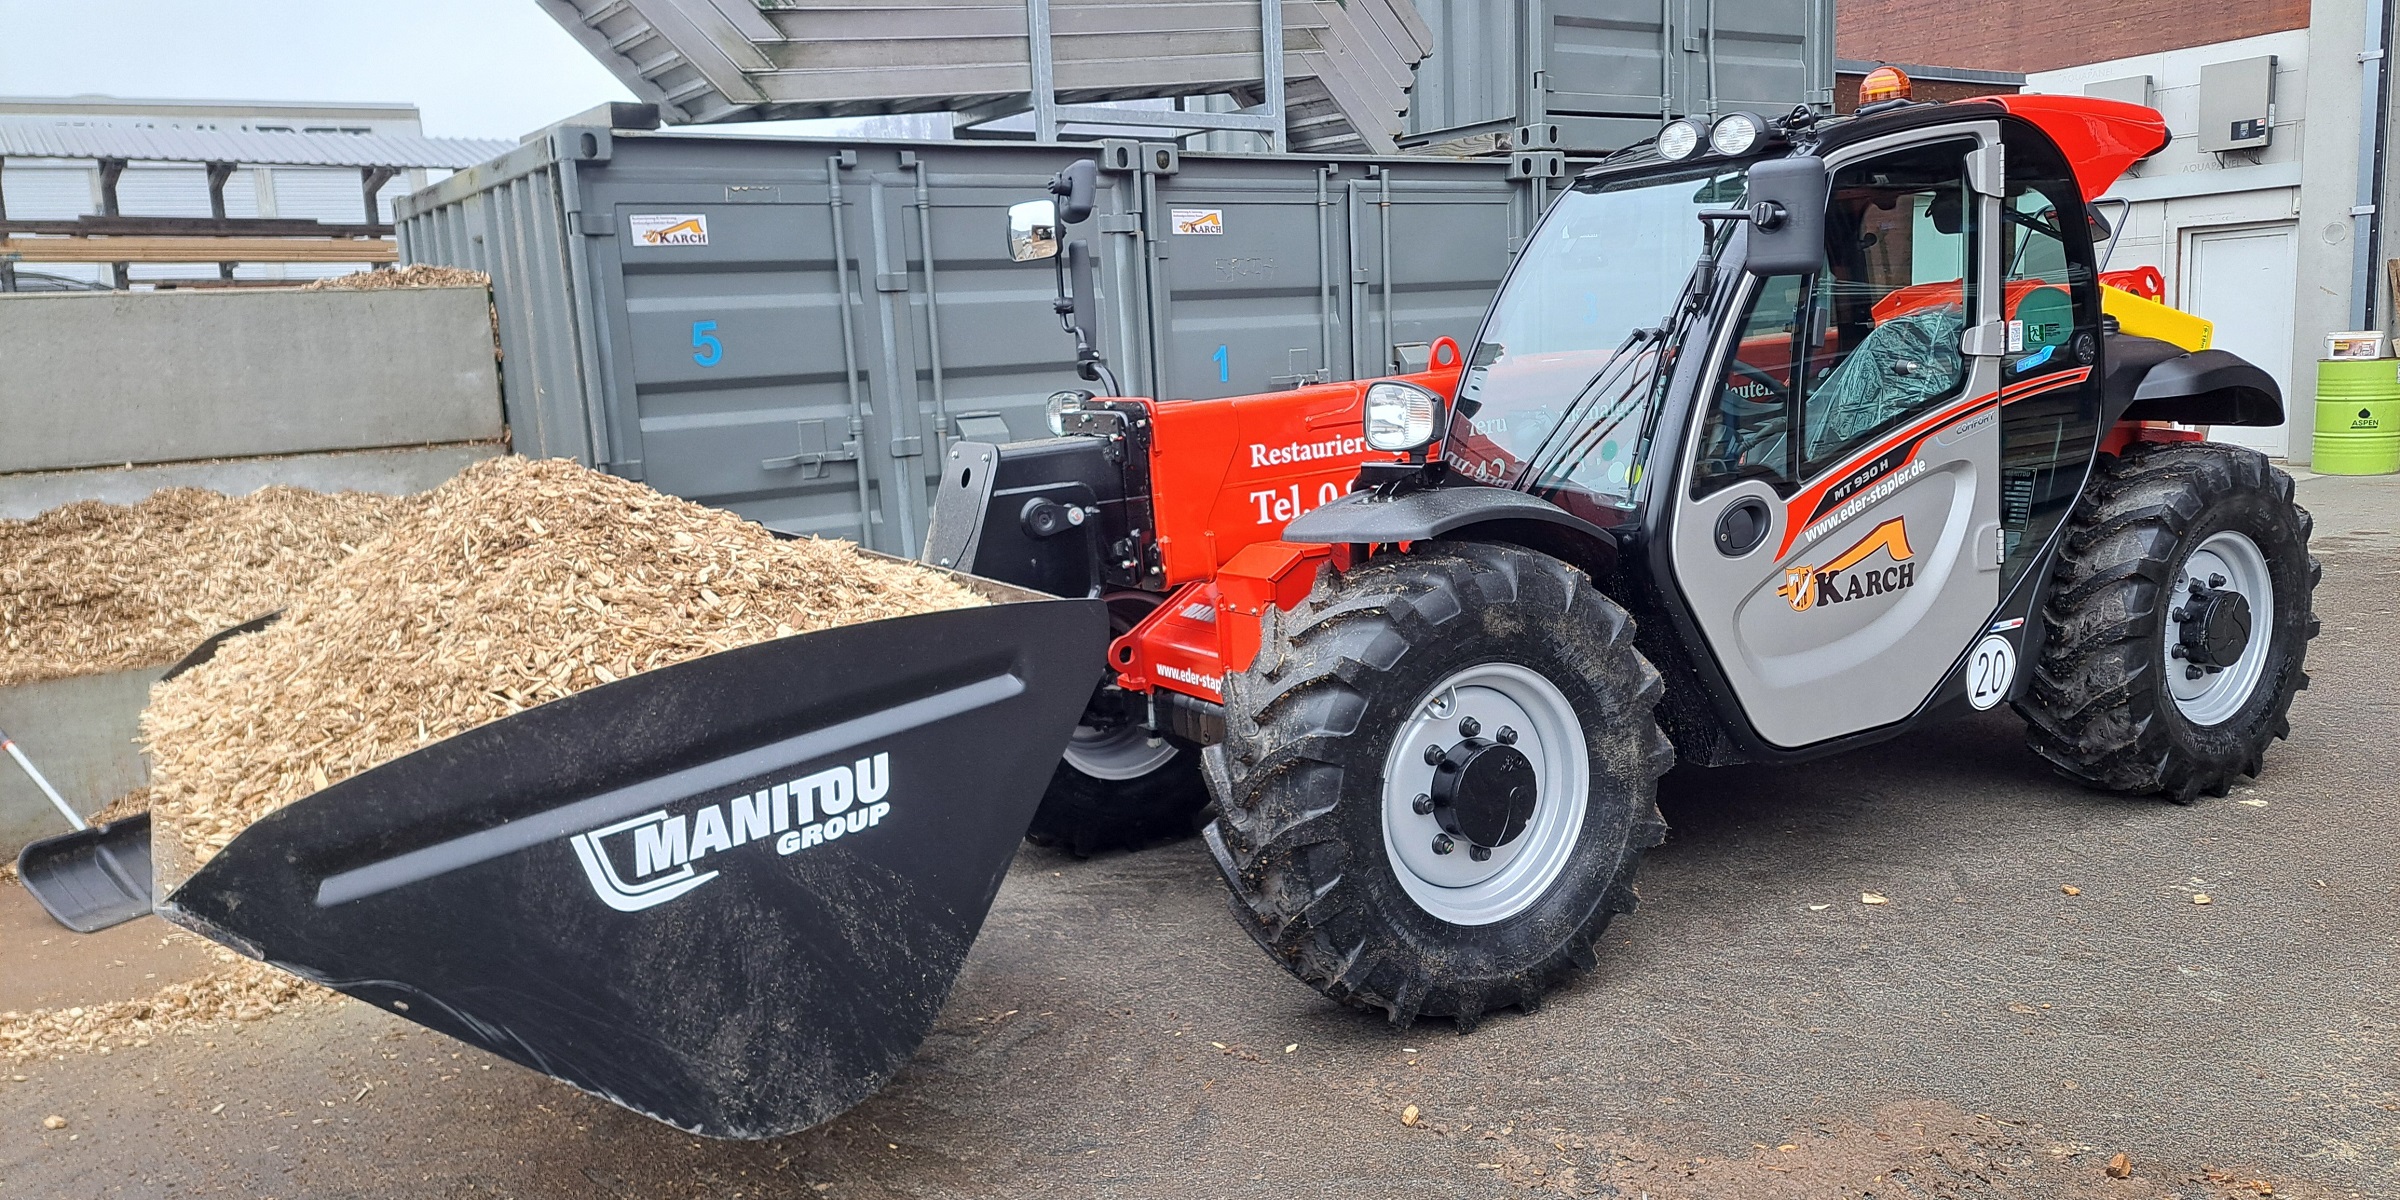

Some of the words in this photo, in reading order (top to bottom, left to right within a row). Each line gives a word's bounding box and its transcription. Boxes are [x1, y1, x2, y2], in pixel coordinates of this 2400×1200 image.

[659, 231, 706, 243] KARCH
[1190, 224, 1221, 233] KARCH
[693, 321, 722, 367] 5
[1213, 345, 1227, 382] 1
[1956, 411, 1995, 435] COMFORT
[1250, 434, 1403, 467] Restaurier
[1834, 482, 1852, 501] MT
[1854, 466, 1879, 489] 930
[1880, 458, 1889, 471] H
[1250, 484, 1311, 524] Tel.
[1805, 458, 1926, 543] www.eder-stapler.de
[1816, 562, 1916, 607] KARCH
[1179, 602, 1216, 623] MAN
[1156, 663, 1224, 694] www.eder-stap
[1975, 649, 2006, 698] 20
[634, 751, 891, 878] MANITOU
[776, 801, 891, 856] GROUP
